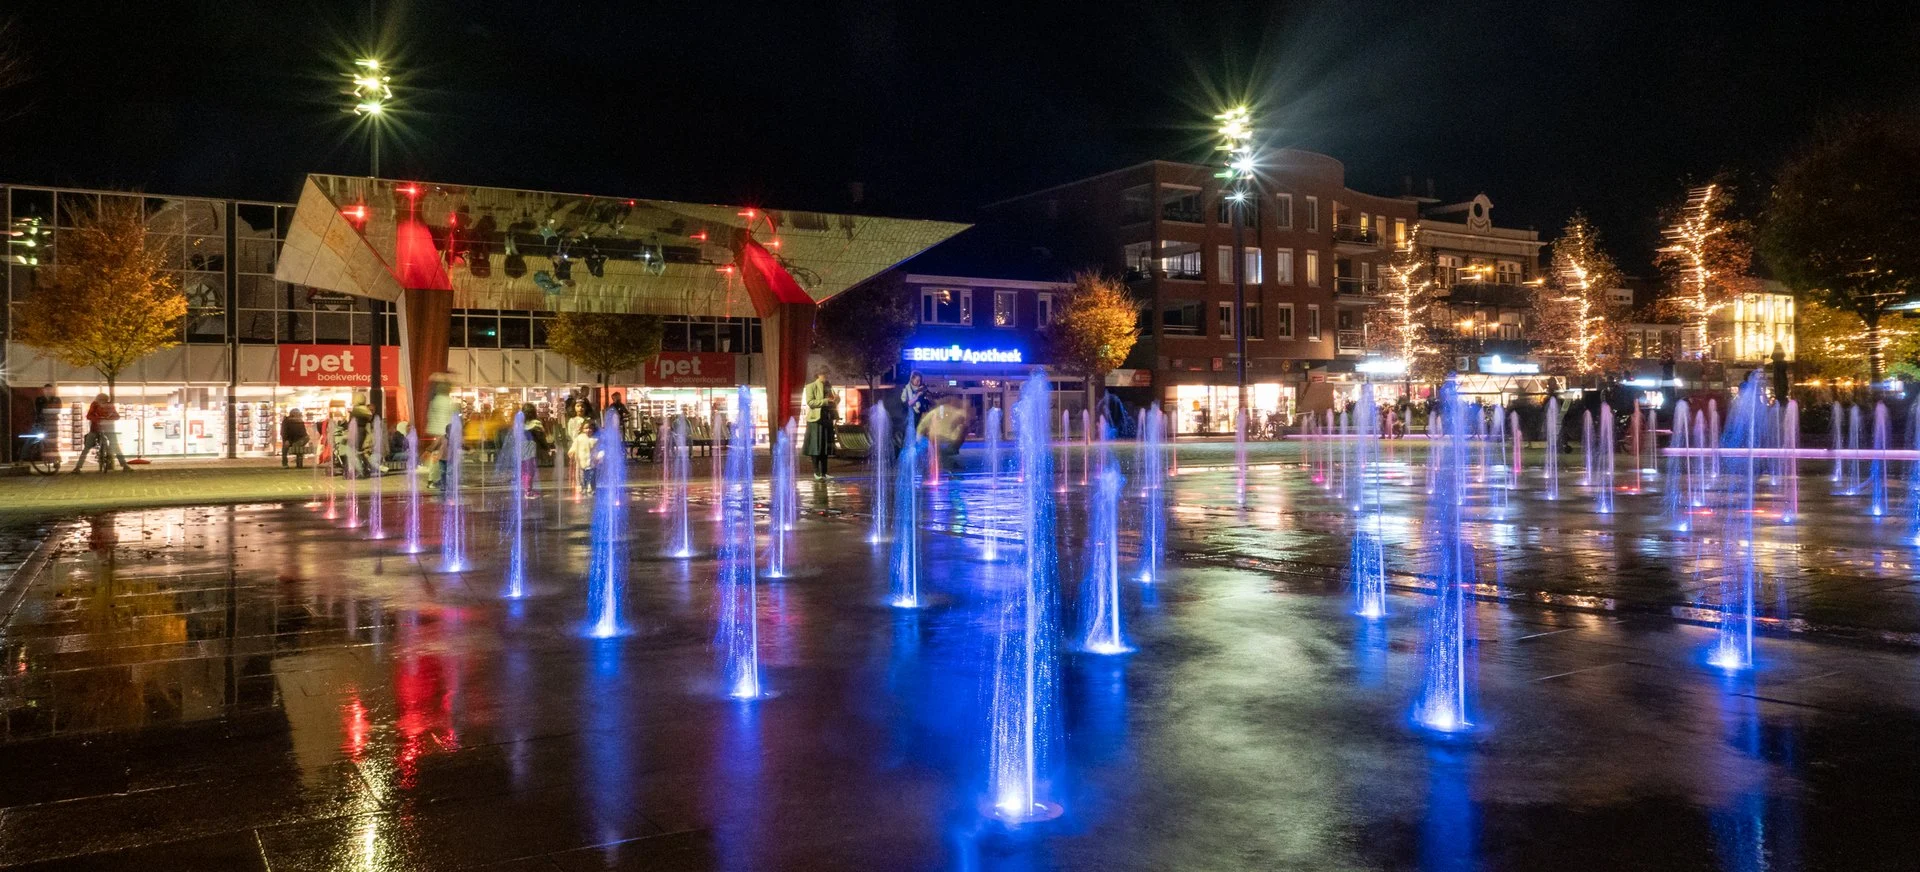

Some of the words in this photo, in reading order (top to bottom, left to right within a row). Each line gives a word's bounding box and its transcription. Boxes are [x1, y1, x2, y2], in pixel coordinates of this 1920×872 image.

[914, 347, 949, 361] BENU
[963, 348, 1021, 364] Apotheek
[317, 373, 388, 382] boekverkops
